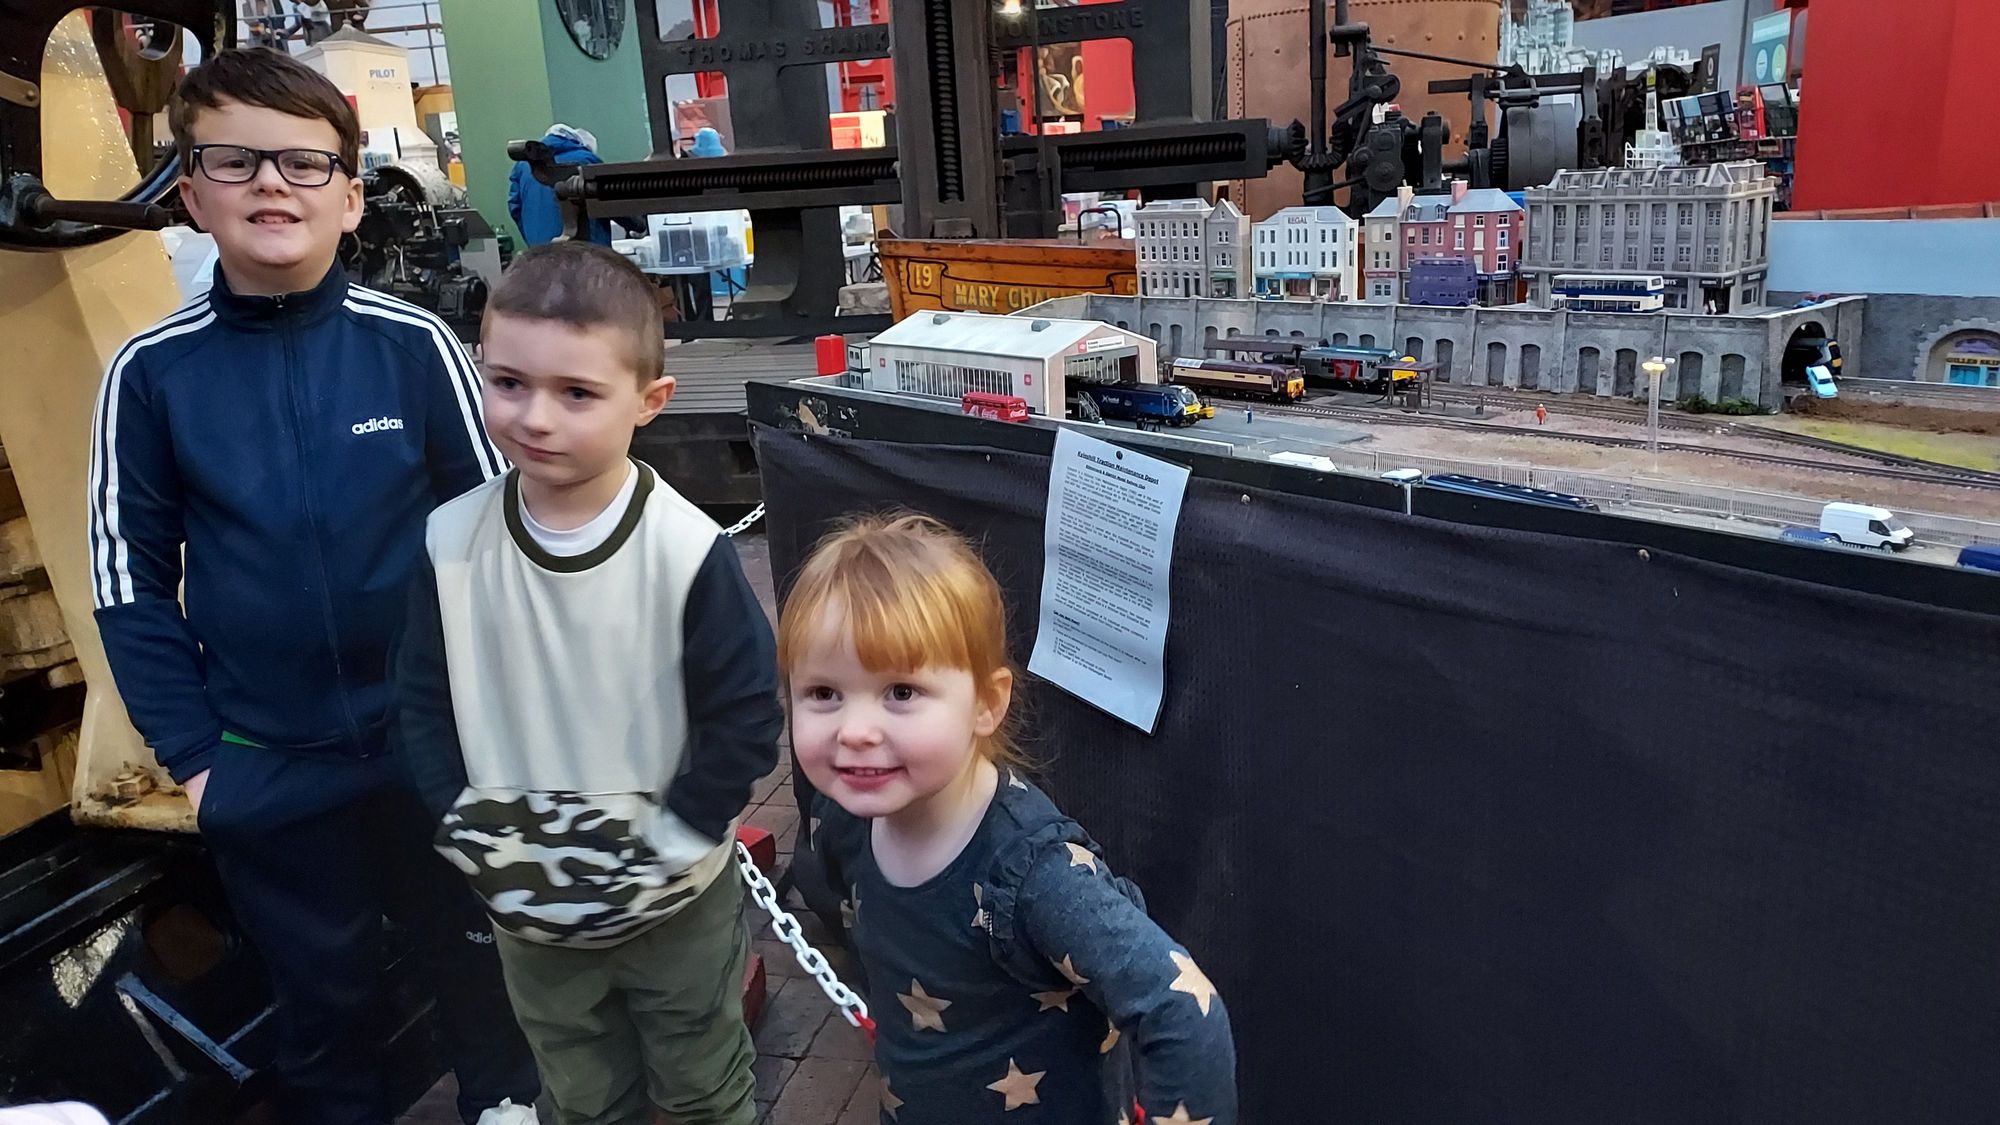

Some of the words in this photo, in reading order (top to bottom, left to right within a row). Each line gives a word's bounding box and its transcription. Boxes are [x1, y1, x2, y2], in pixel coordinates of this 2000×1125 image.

[679, 42, 786, 65] THOMAS
[804, 30, 889, 55] SHANK
[369, 69, 395, 78] PILOT
[914, 265, 932, 287] 19
[955, 284, 1000, 308] MARY
[351, 416, 404, 435] adidas
[1115, 464, 1144, 480] Maintenance
[1144, 474, 1159, 485] Depot
[465, 931, 497, 944] adid
